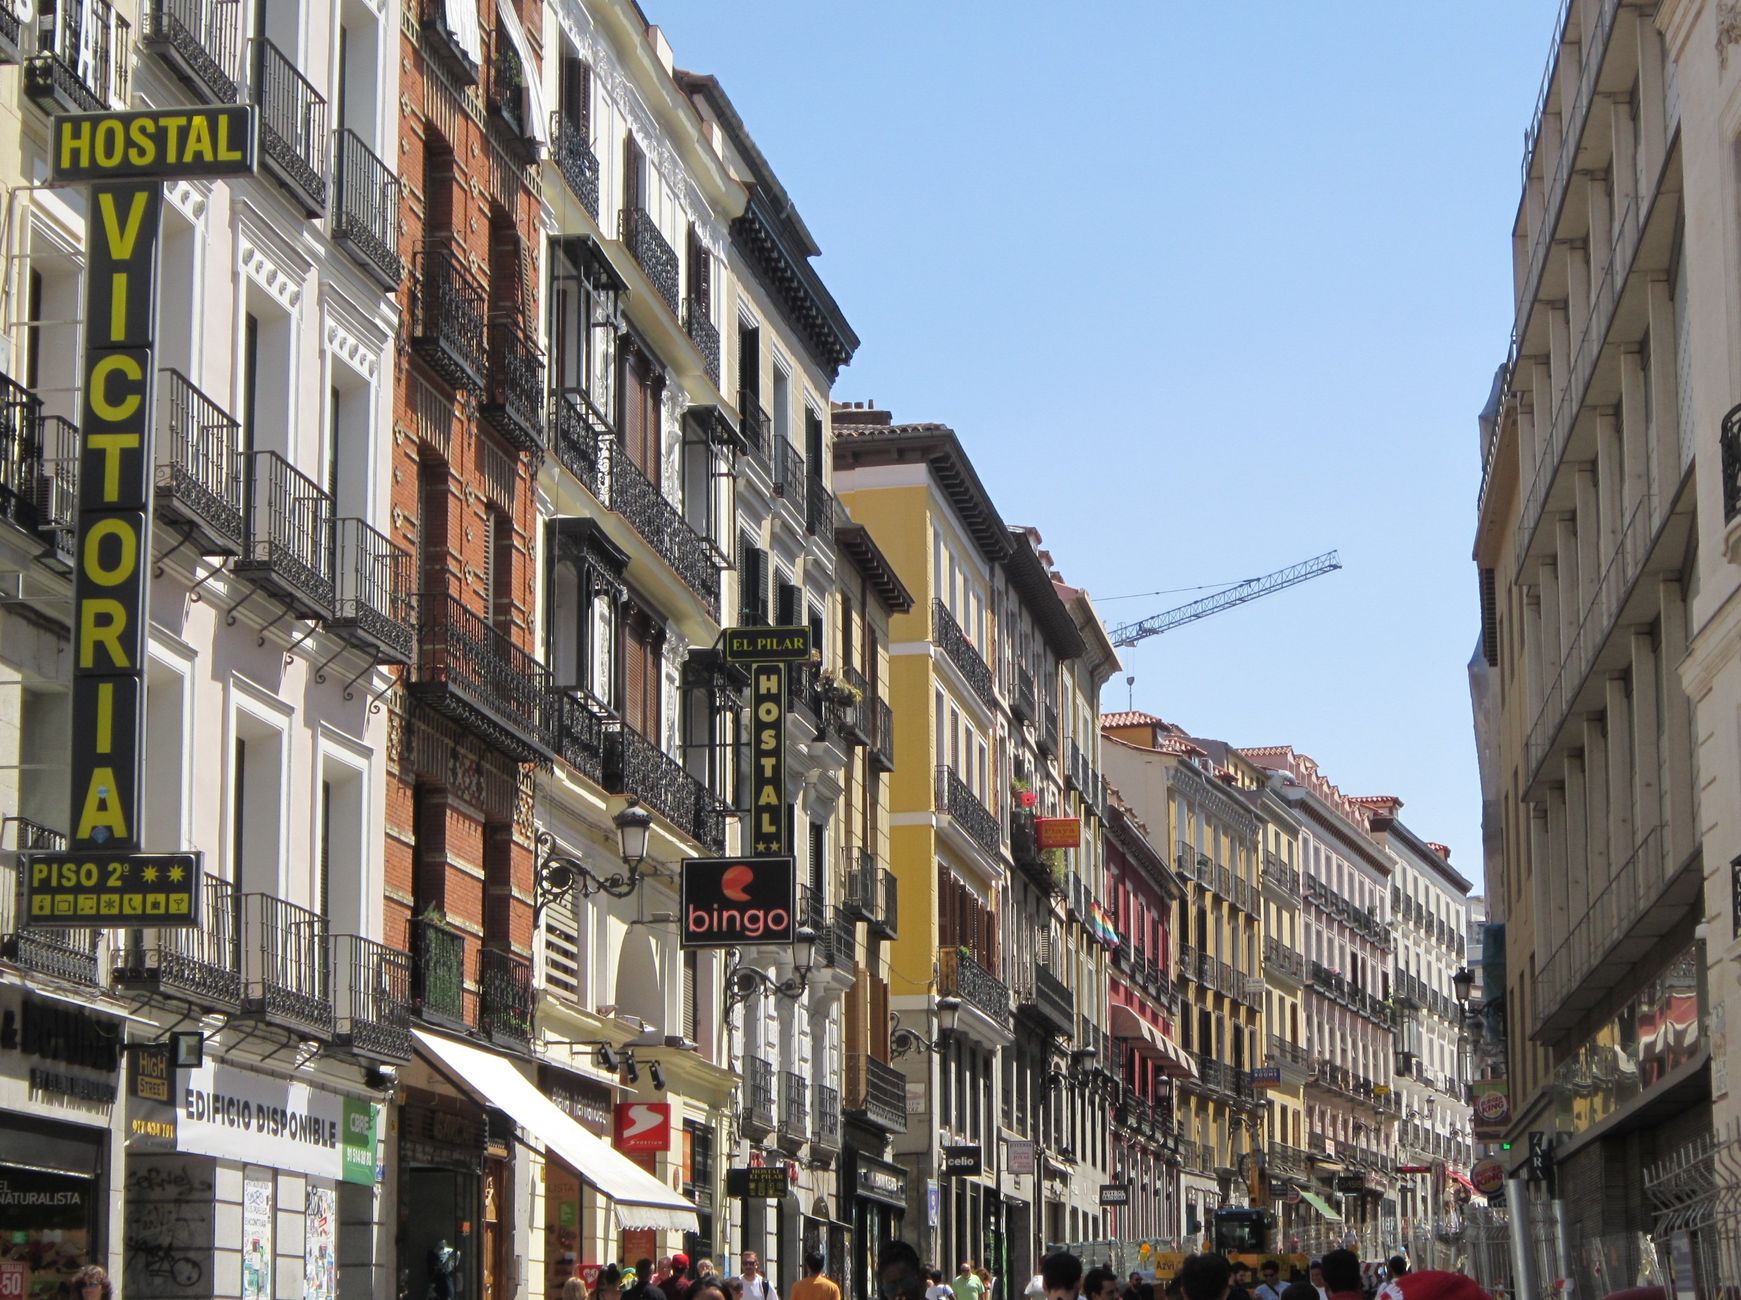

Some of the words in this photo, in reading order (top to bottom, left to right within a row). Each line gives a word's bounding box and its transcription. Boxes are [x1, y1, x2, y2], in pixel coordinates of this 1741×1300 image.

[60, 113, 242, 169] HOSTAL
[76, 191, 149, 840] VICTORIA
[732, 638, 751, 650] EL
[757, 638, 804, 650] PILAR
[758, 674, 779, 833] HOSTAL
[32, 862, 98, 888] PISO
[688, 904, 788, 937] bingo
[140, 1052, 166, 1078] HIGH
[140, 1079, 166, 1098] STREET
[185, 1088, 252, 1131] EDIFICIO
[256, 1103, 336, 1149] DISPONIBLE
[1482, 1101, 1504, 1114] KING
[948, 1156, 974, 1166] celio
